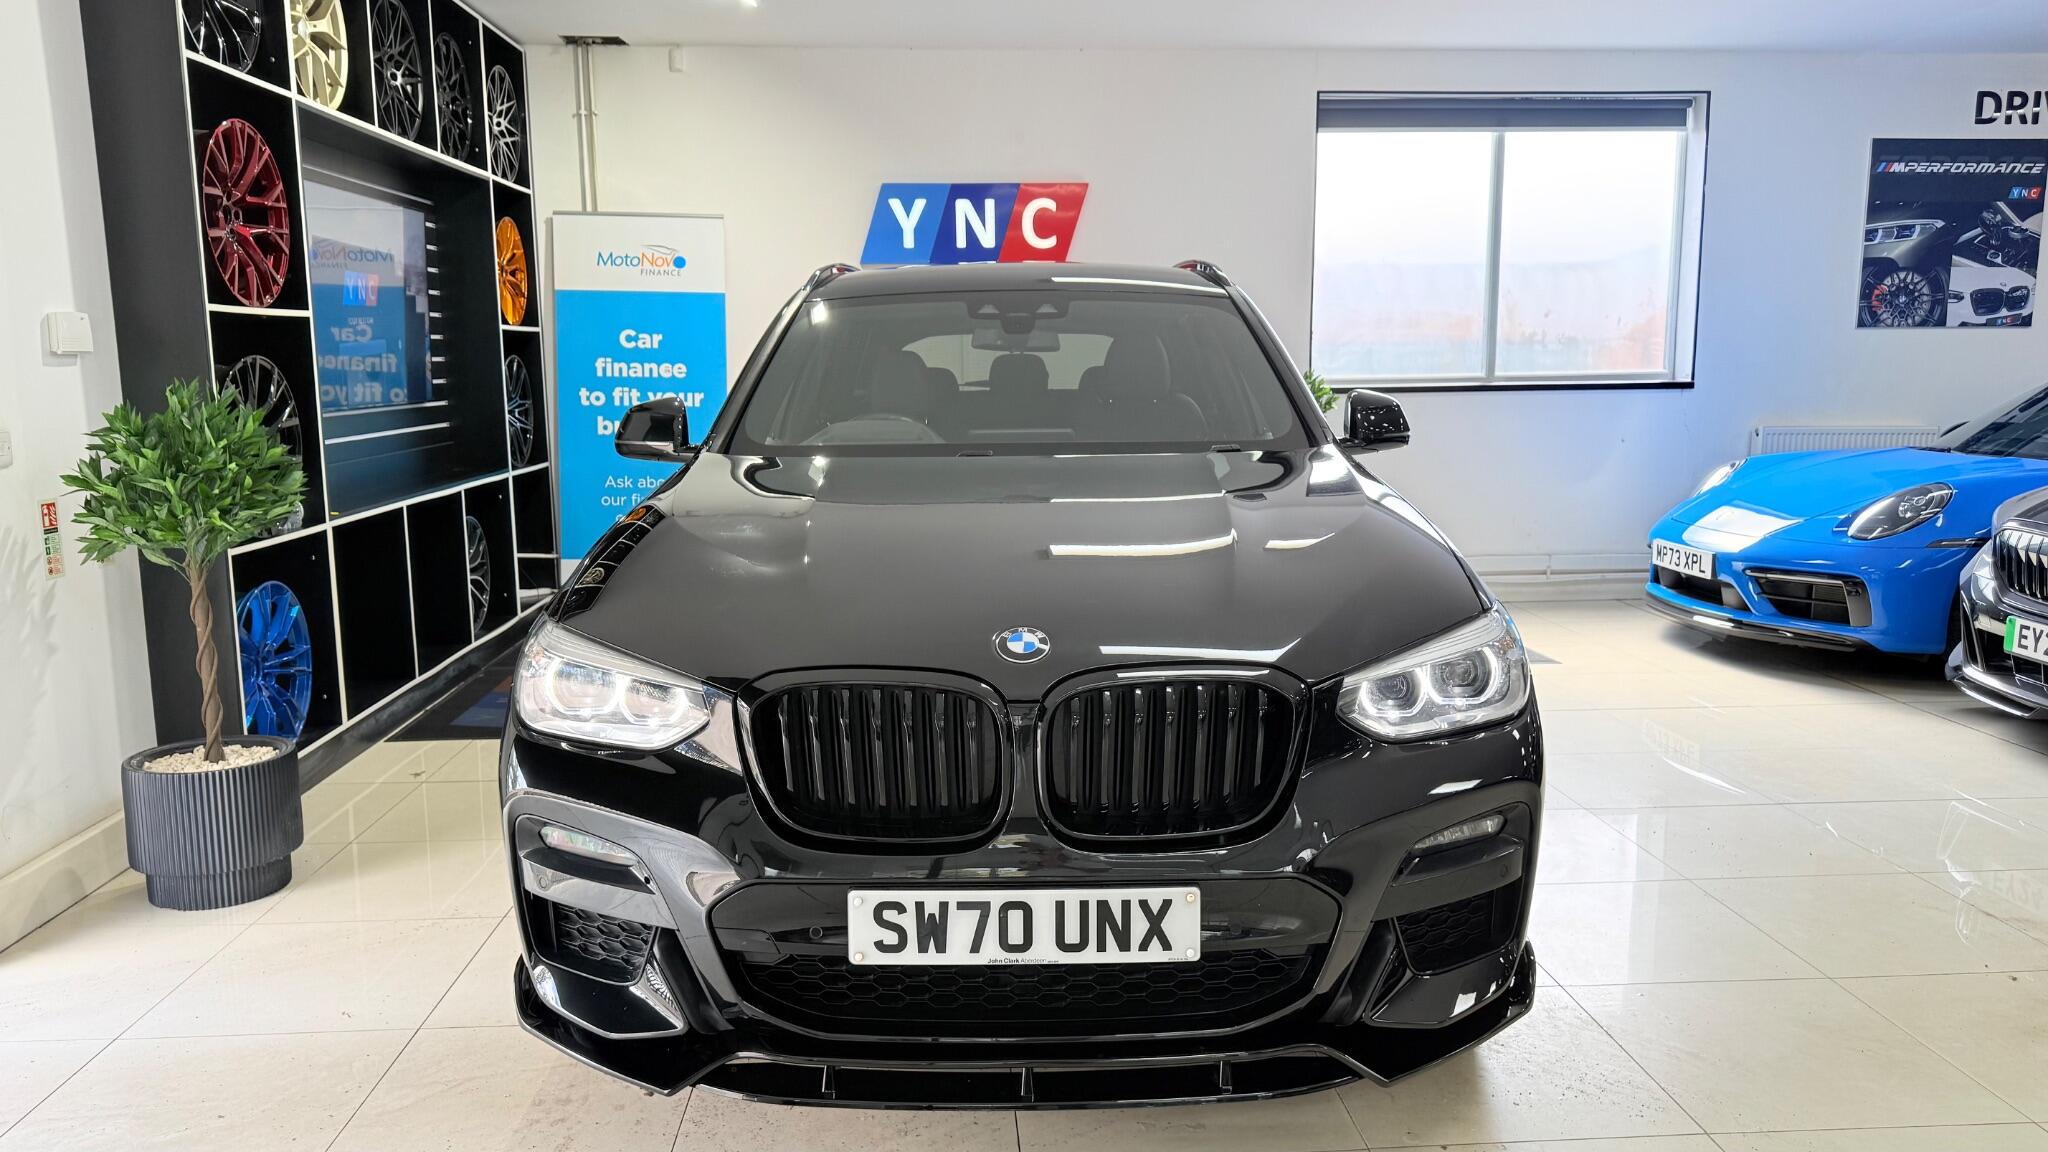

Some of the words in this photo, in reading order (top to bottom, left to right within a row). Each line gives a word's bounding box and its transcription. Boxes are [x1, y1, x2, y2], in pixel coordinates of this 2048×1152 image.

[1974, 90, 2048, 125] DRI
[2012, 188, 2038, 198] YNC
[887, 197, 1058, 249] YNC
[640, 269, 682, 277] FINANCE
[619, 329, 663, 349] Car
[595, 357, 687, 378] finance
[579, 388, 606, 406] to
[612, 387, 640, 406] fit
[605, 475, 633, 488] Ask
[601, 495, 627, 506] our
[1656, 543, 1681, 567] MP73
[1684, 551, 1706, 574] XPL
[872, 900, 1034, 954] SW70
[1054, 899, 1174, 953] UNX
